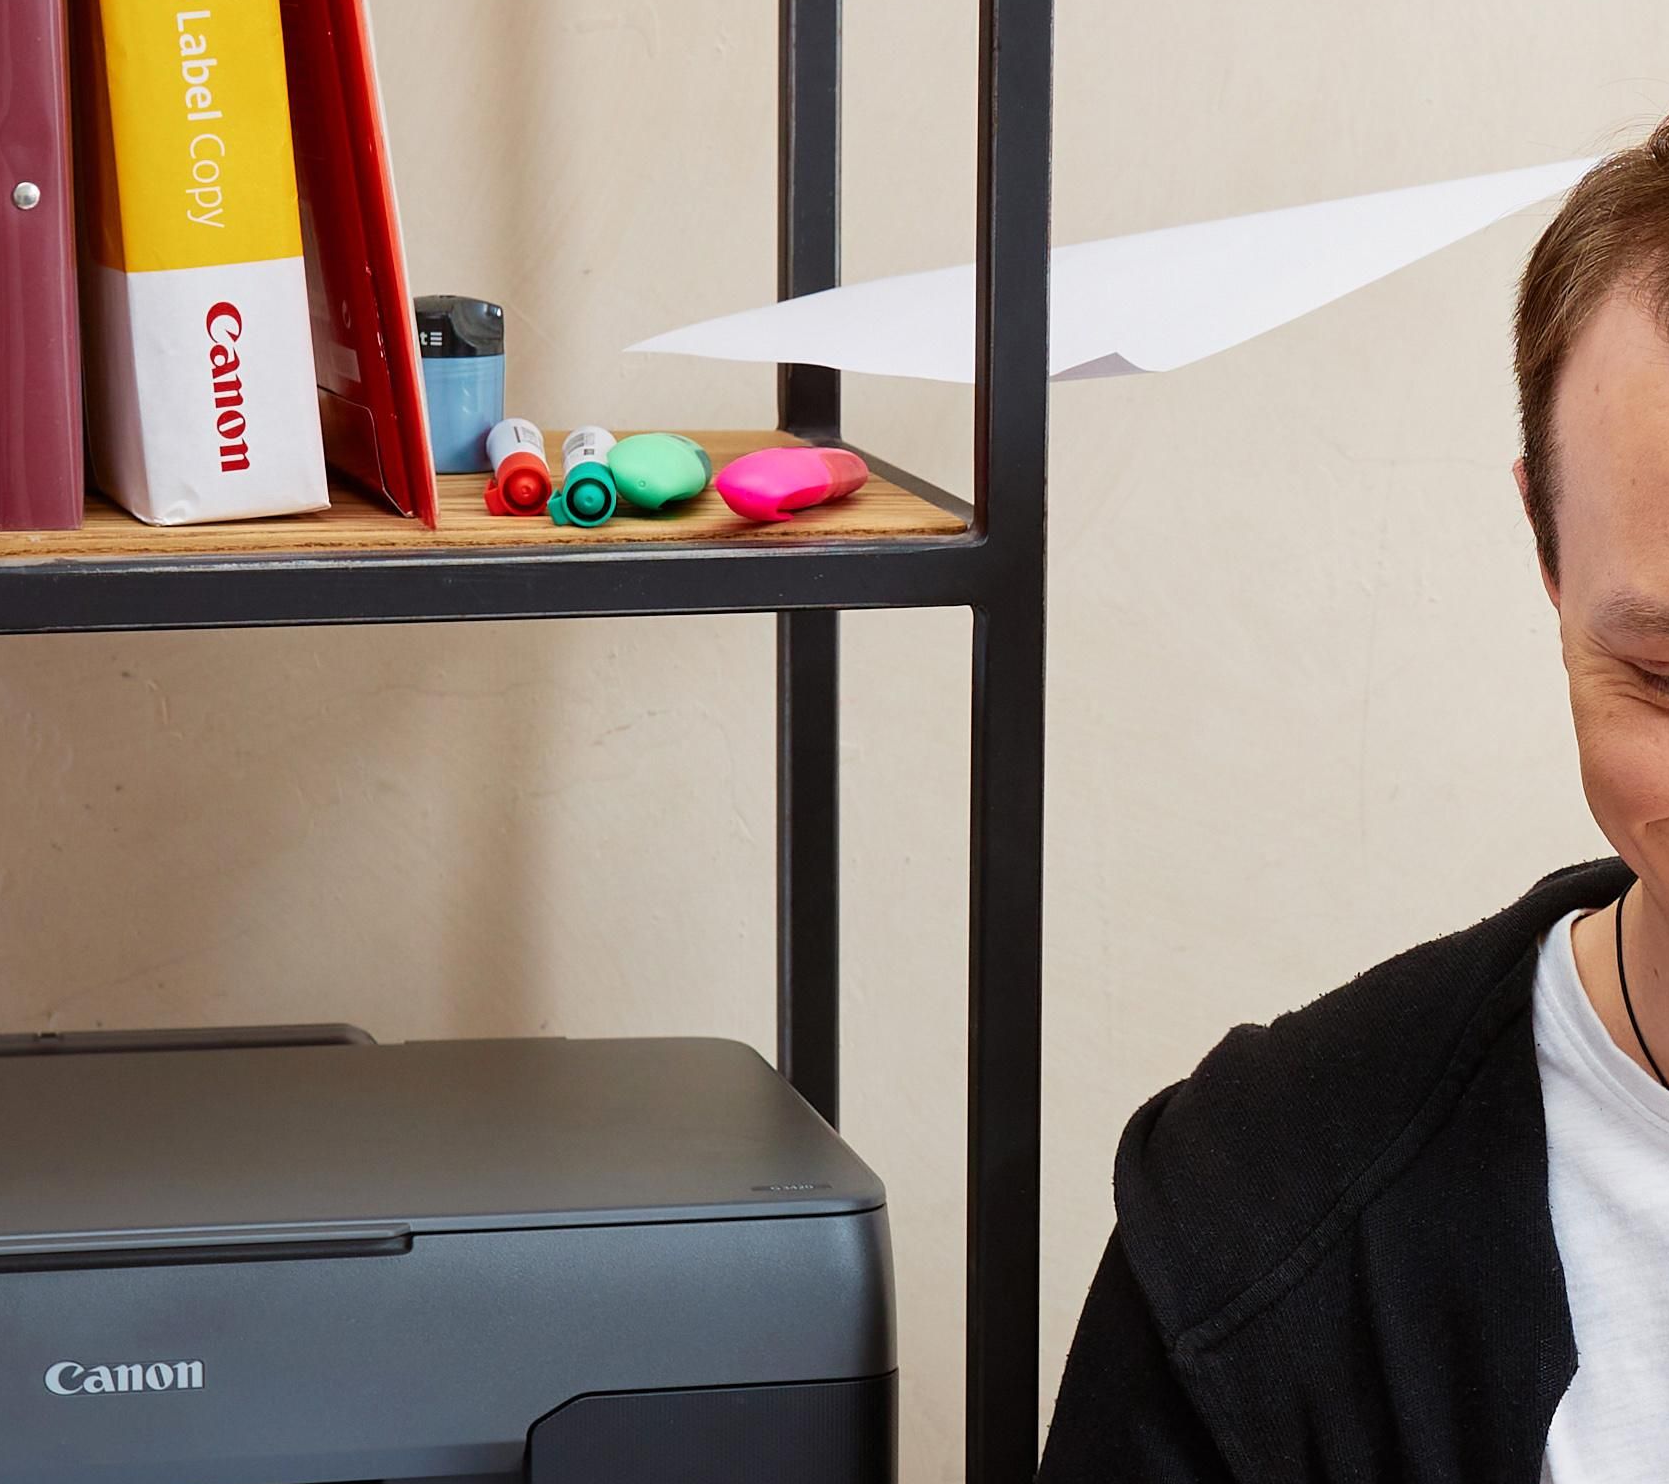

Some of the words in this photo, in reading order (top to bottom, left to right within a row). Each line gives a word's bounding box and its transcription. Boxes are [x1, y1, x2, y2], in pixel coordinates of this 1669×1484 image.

[177, 10, 222, 120] Label
[186, 132, 226, 229] Copy
[206, 301, 247, 474] Canon
[44, 1361, 203, 1395] Canon
